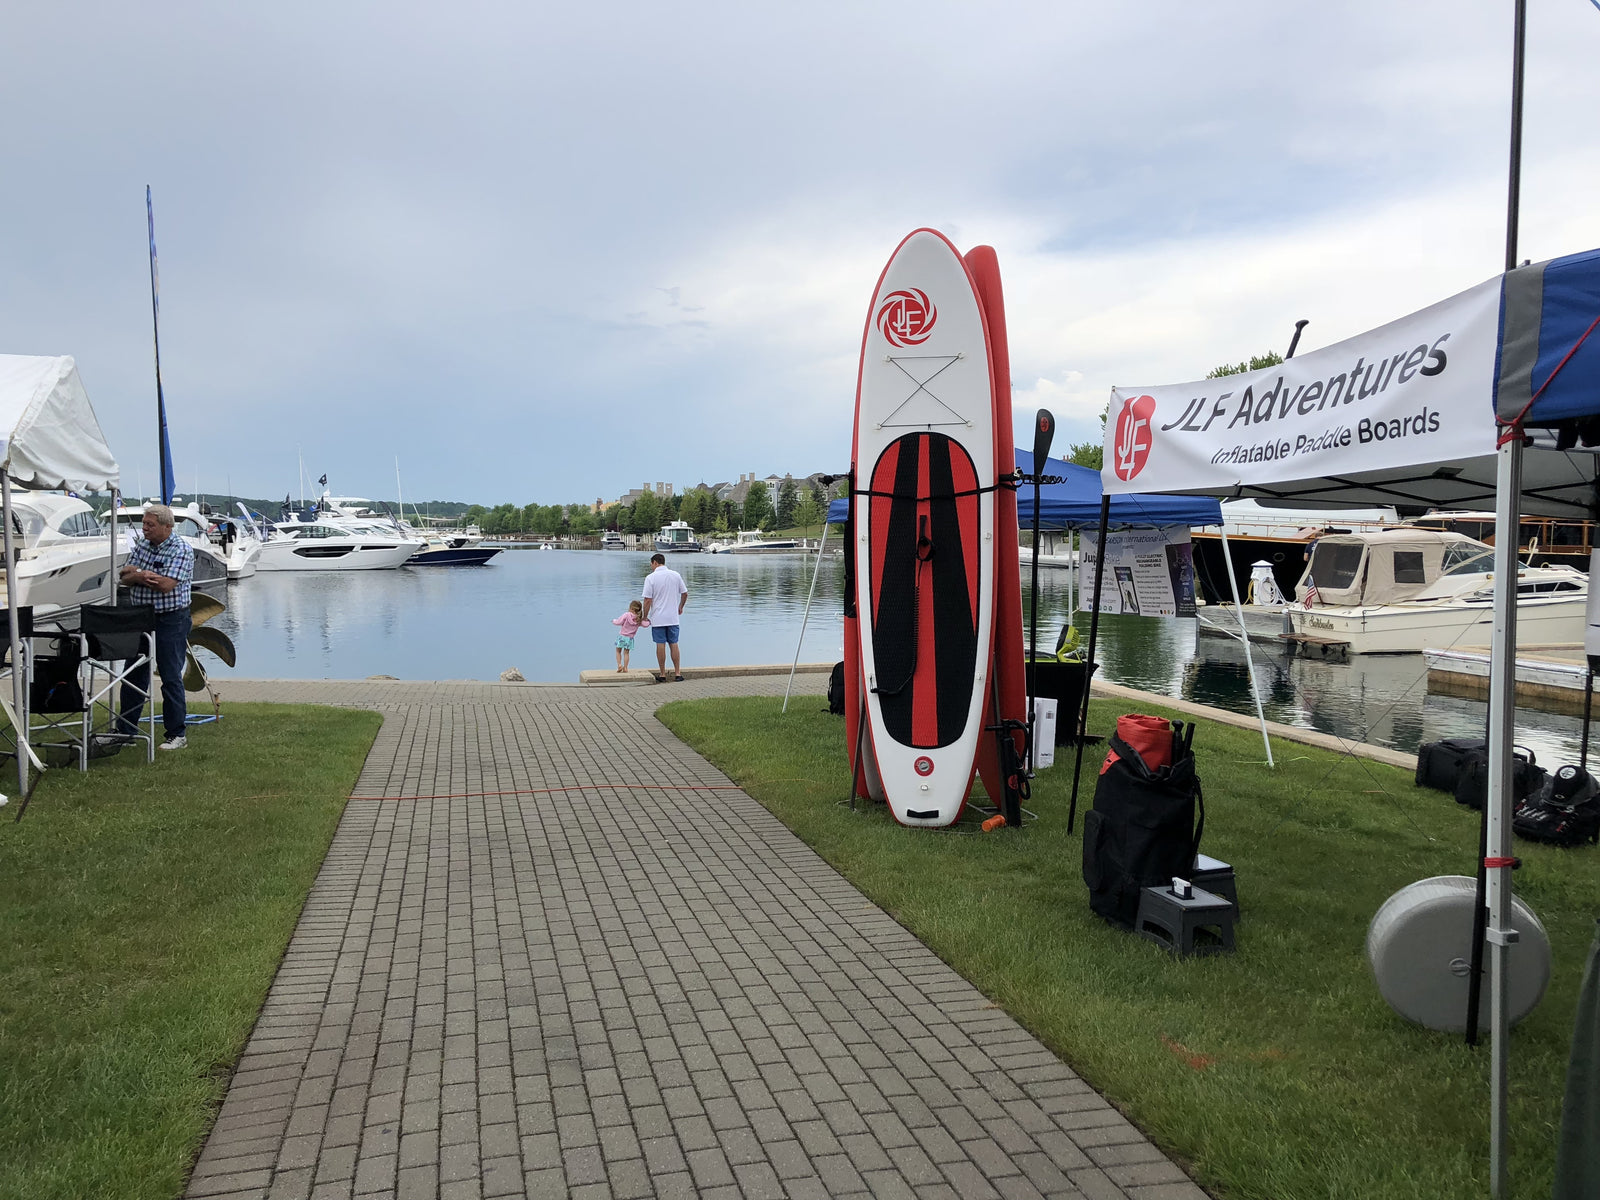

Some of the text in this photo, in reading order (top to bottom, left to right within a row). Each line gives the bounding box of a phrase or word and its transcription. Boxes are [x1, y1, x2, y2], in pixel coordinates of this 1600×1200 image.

[1161, 332, 1451, 432] JLF Adventures
[1211, 406, 1440, 465] Inflatable Paddle Boards
